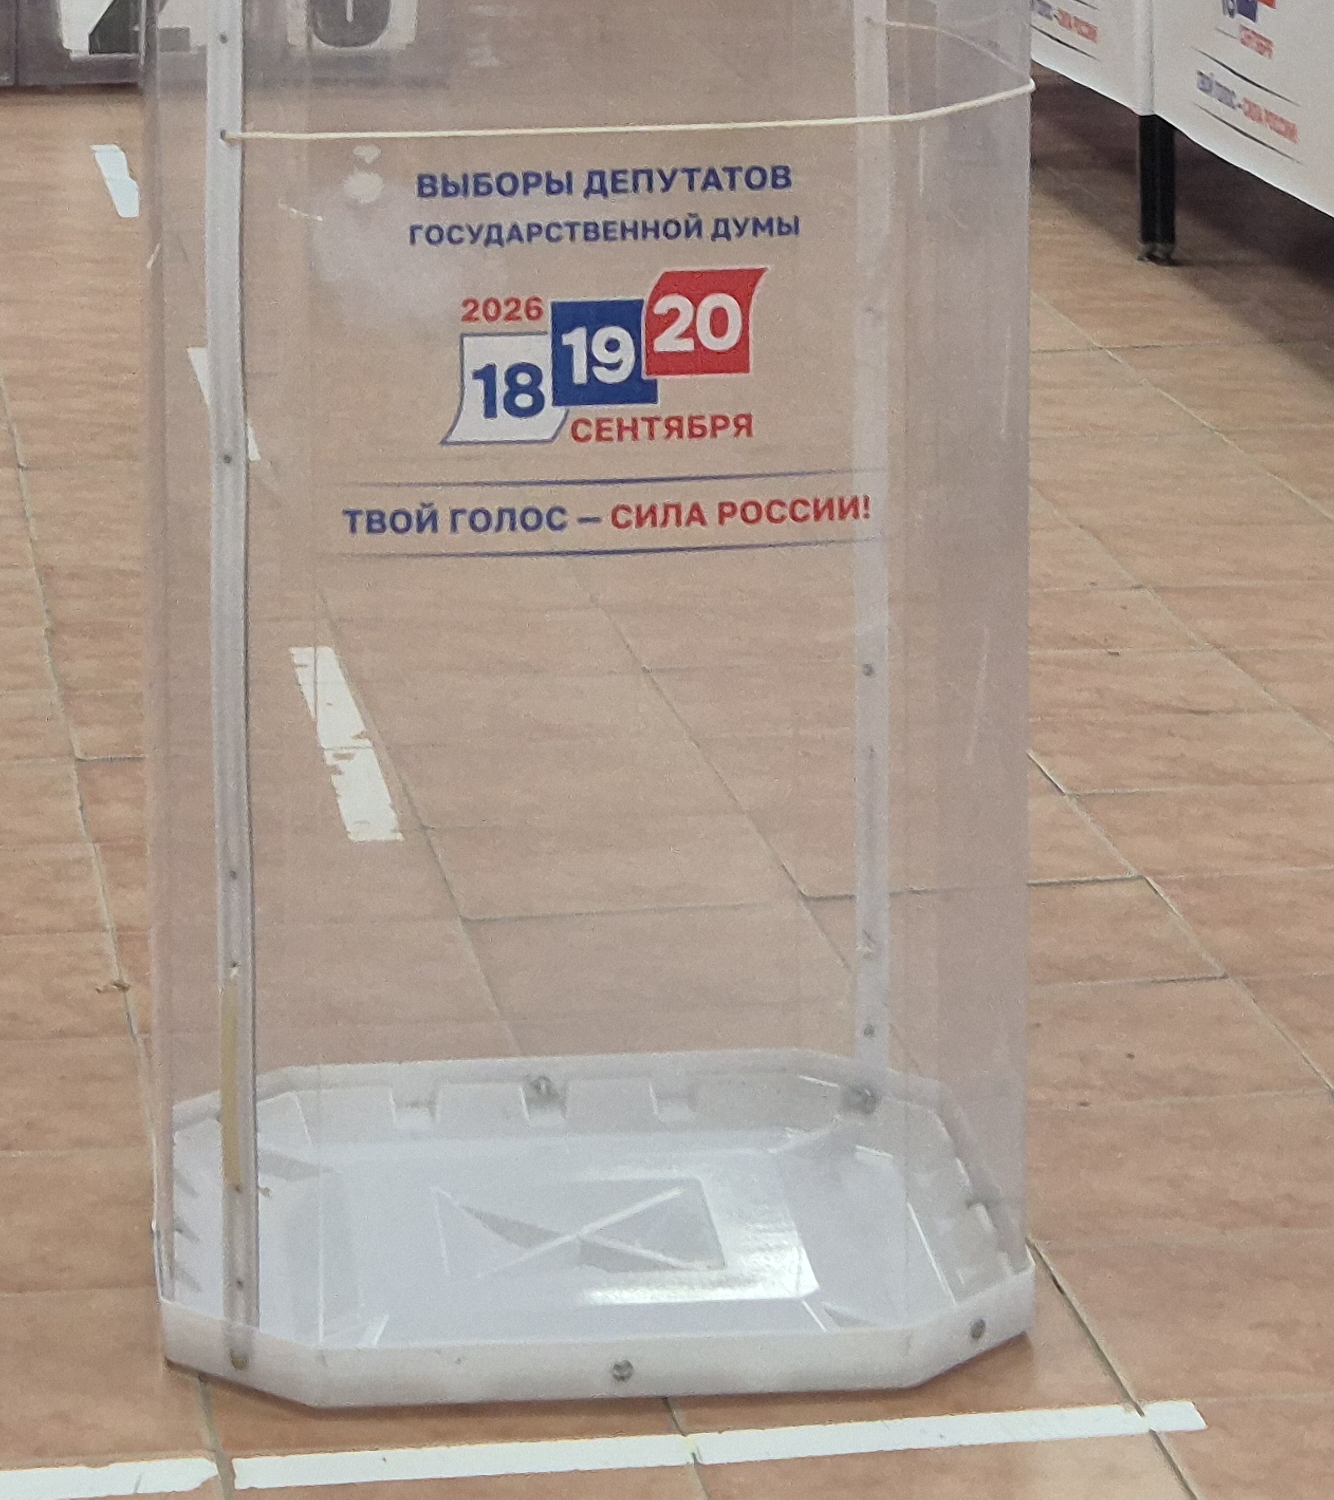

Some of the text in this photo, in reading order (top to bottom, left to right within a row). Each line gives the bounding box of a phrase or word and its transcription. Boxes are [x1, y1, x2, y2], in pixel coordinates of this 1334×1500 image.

[415, 163, 793, 200] ВЫБОРЫ ДЕПУТАТОВ
[409, 212, 800, 248] ГОСУДАРСТВЕННОЙ ДУМЫ
[460, 295, 544, 323] 2026
[471, 292, 743, 420] 18 19 20
[570, 411, 754, 444] СЕНТЯБРЯ
[342, 501, 439, 536] ТВОЙ
[448, 506, 568, 535] ГОЛОС
[610, 501, 707, 531] СИЛА
[715, 494, 871, 528] РОССИИ!
